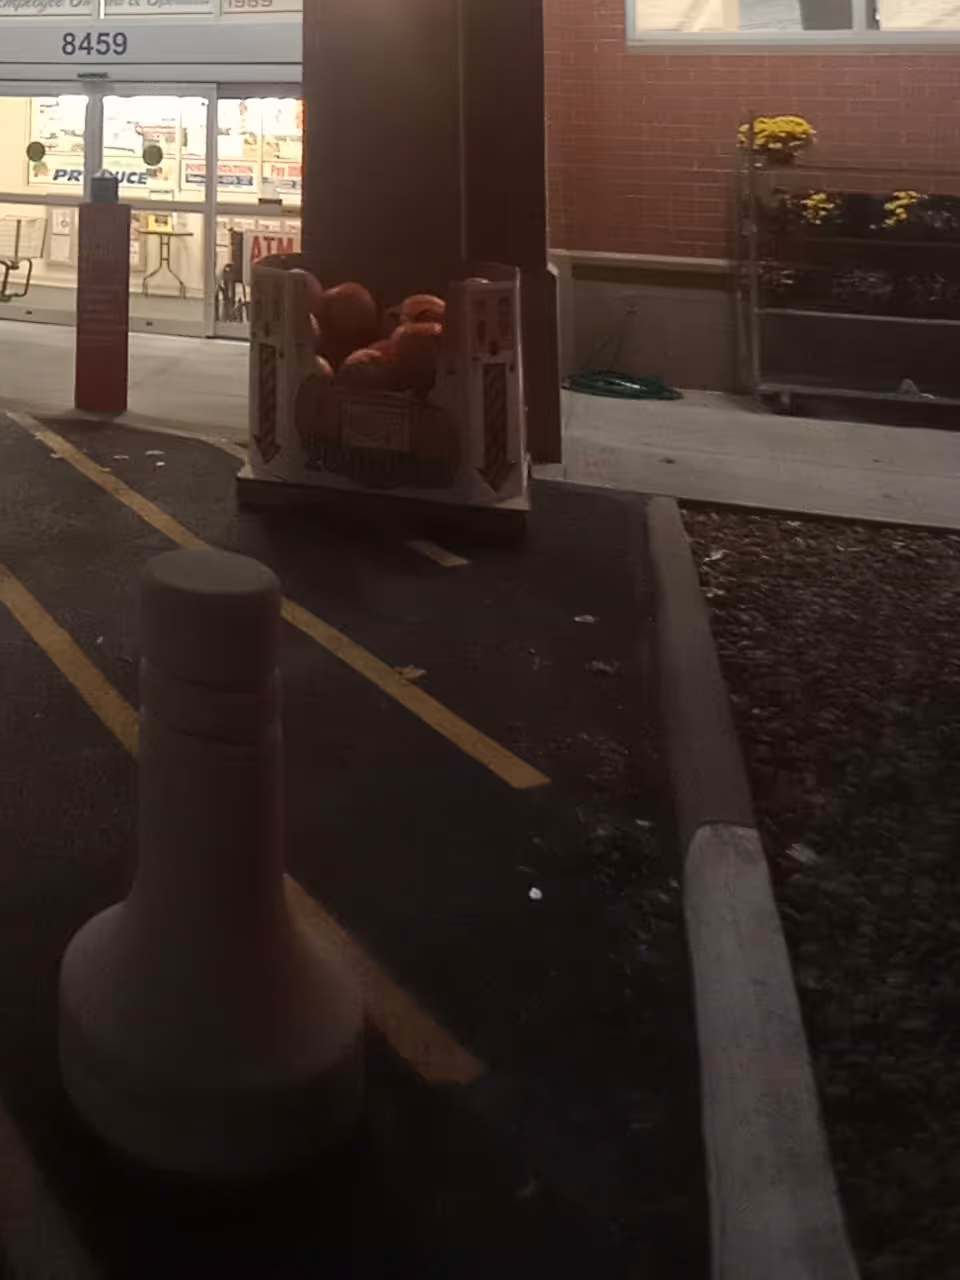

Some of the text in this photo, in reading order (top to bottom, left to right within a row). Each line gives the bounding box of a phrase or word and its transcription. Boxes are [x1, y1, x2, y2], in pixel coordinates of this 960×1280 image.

[62, 32, 127, 56] 8459
[52, 169, 148, 185] PRUCE
[250, 235, 295, 261] ATM
